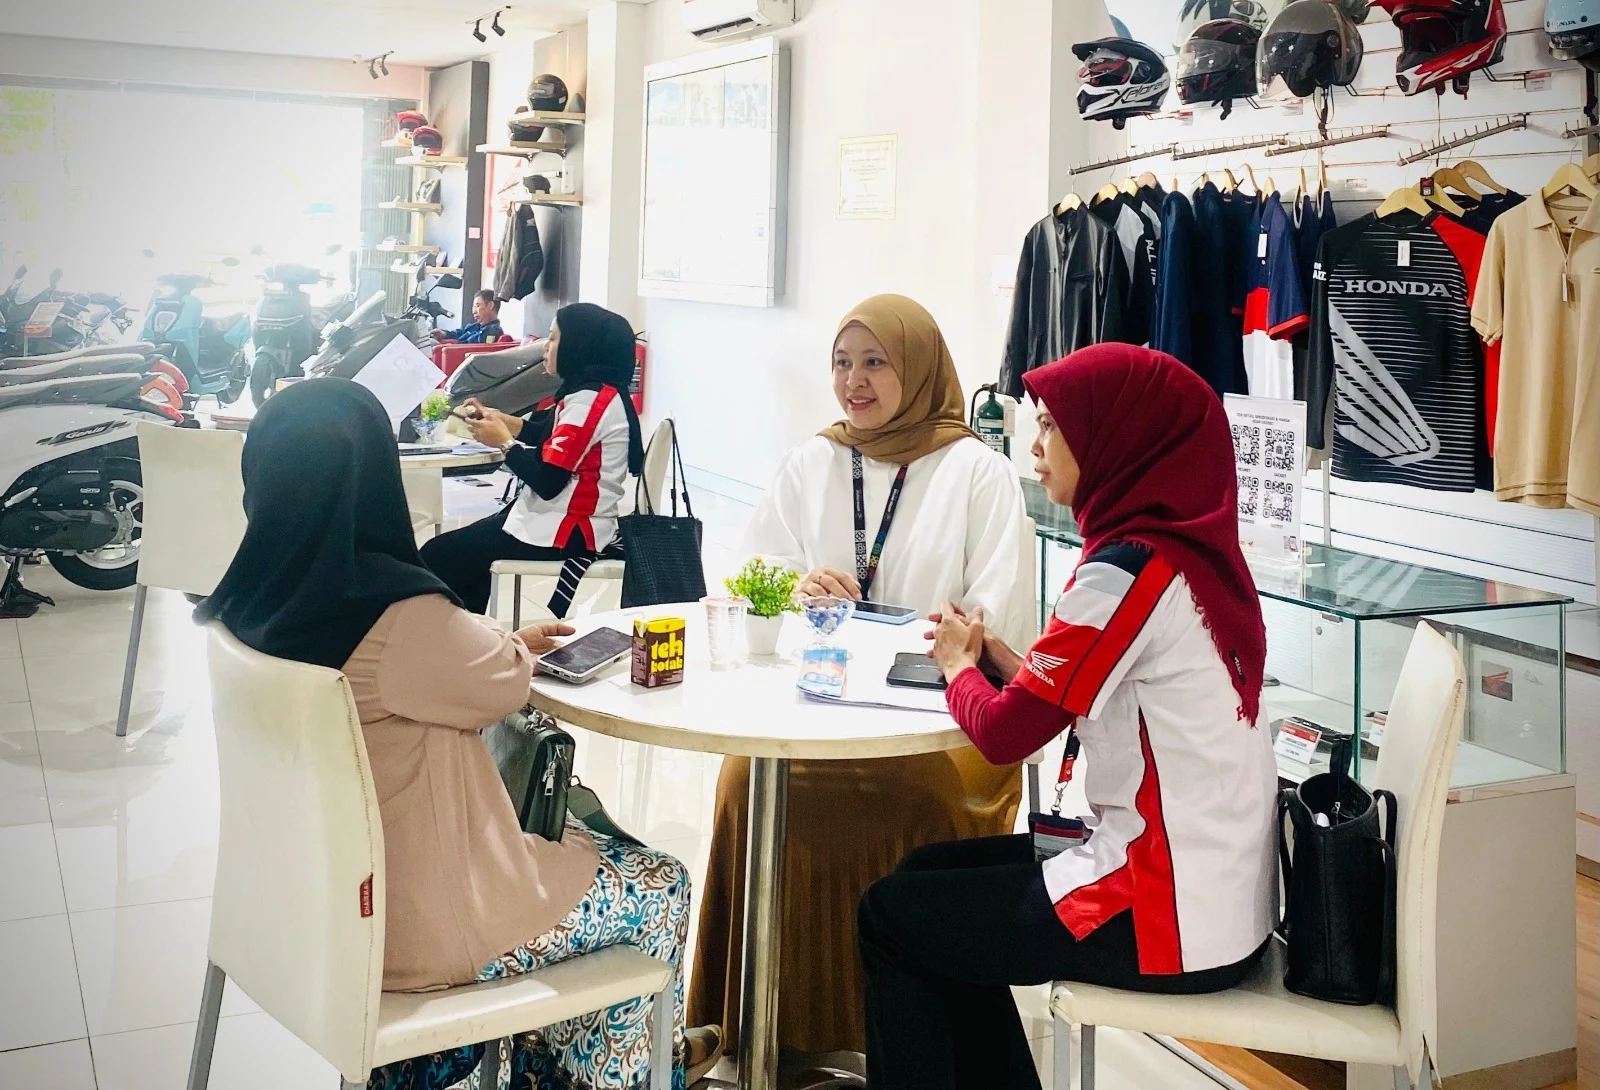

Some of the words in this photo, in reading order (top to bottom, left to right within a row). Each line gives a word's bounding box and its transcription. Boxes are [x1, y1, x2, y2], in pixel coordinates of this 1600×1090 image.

[1344, 279, 1453, 298] HONDA
[651, 632, 684, 660] teh
[650, 656, 683, 673] kotak
